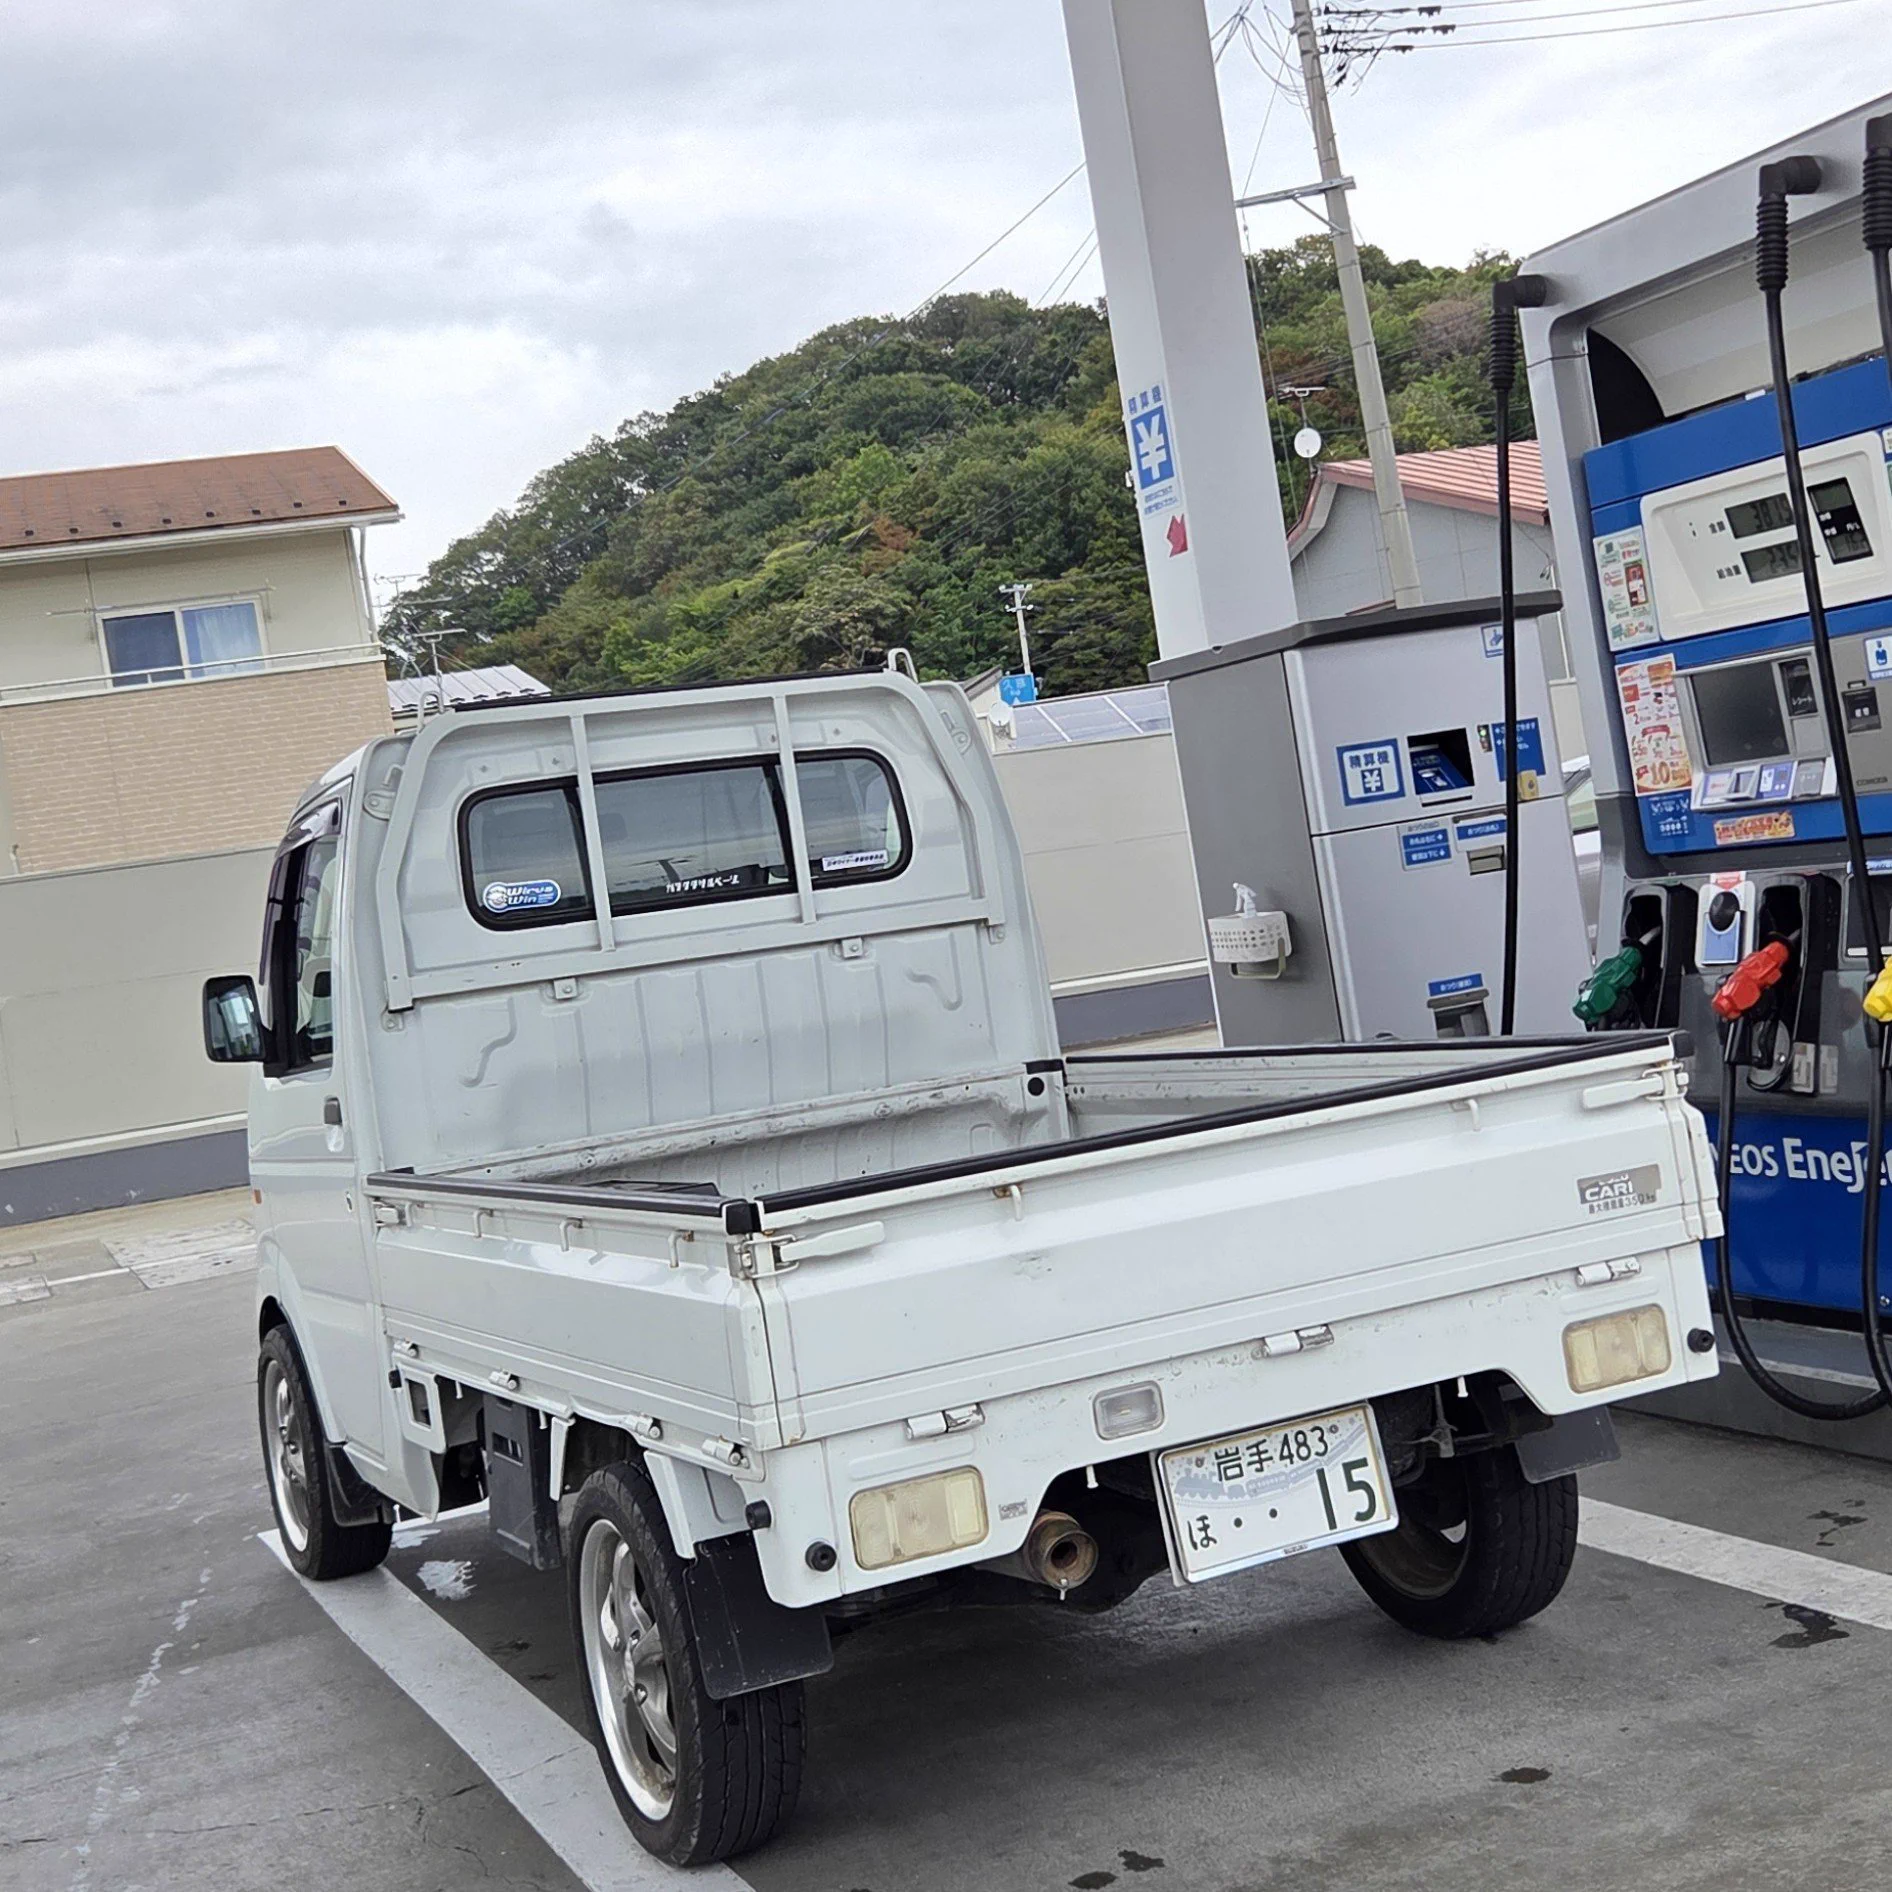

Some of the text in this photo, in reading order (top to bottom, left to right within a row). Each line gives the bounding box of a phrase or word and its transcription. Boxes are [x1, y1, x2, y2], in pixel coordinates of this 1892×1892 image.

[1709, 1137, 1892, 1193] EOS EneJ
[1187, 1515, 1217, 1551] ほ
